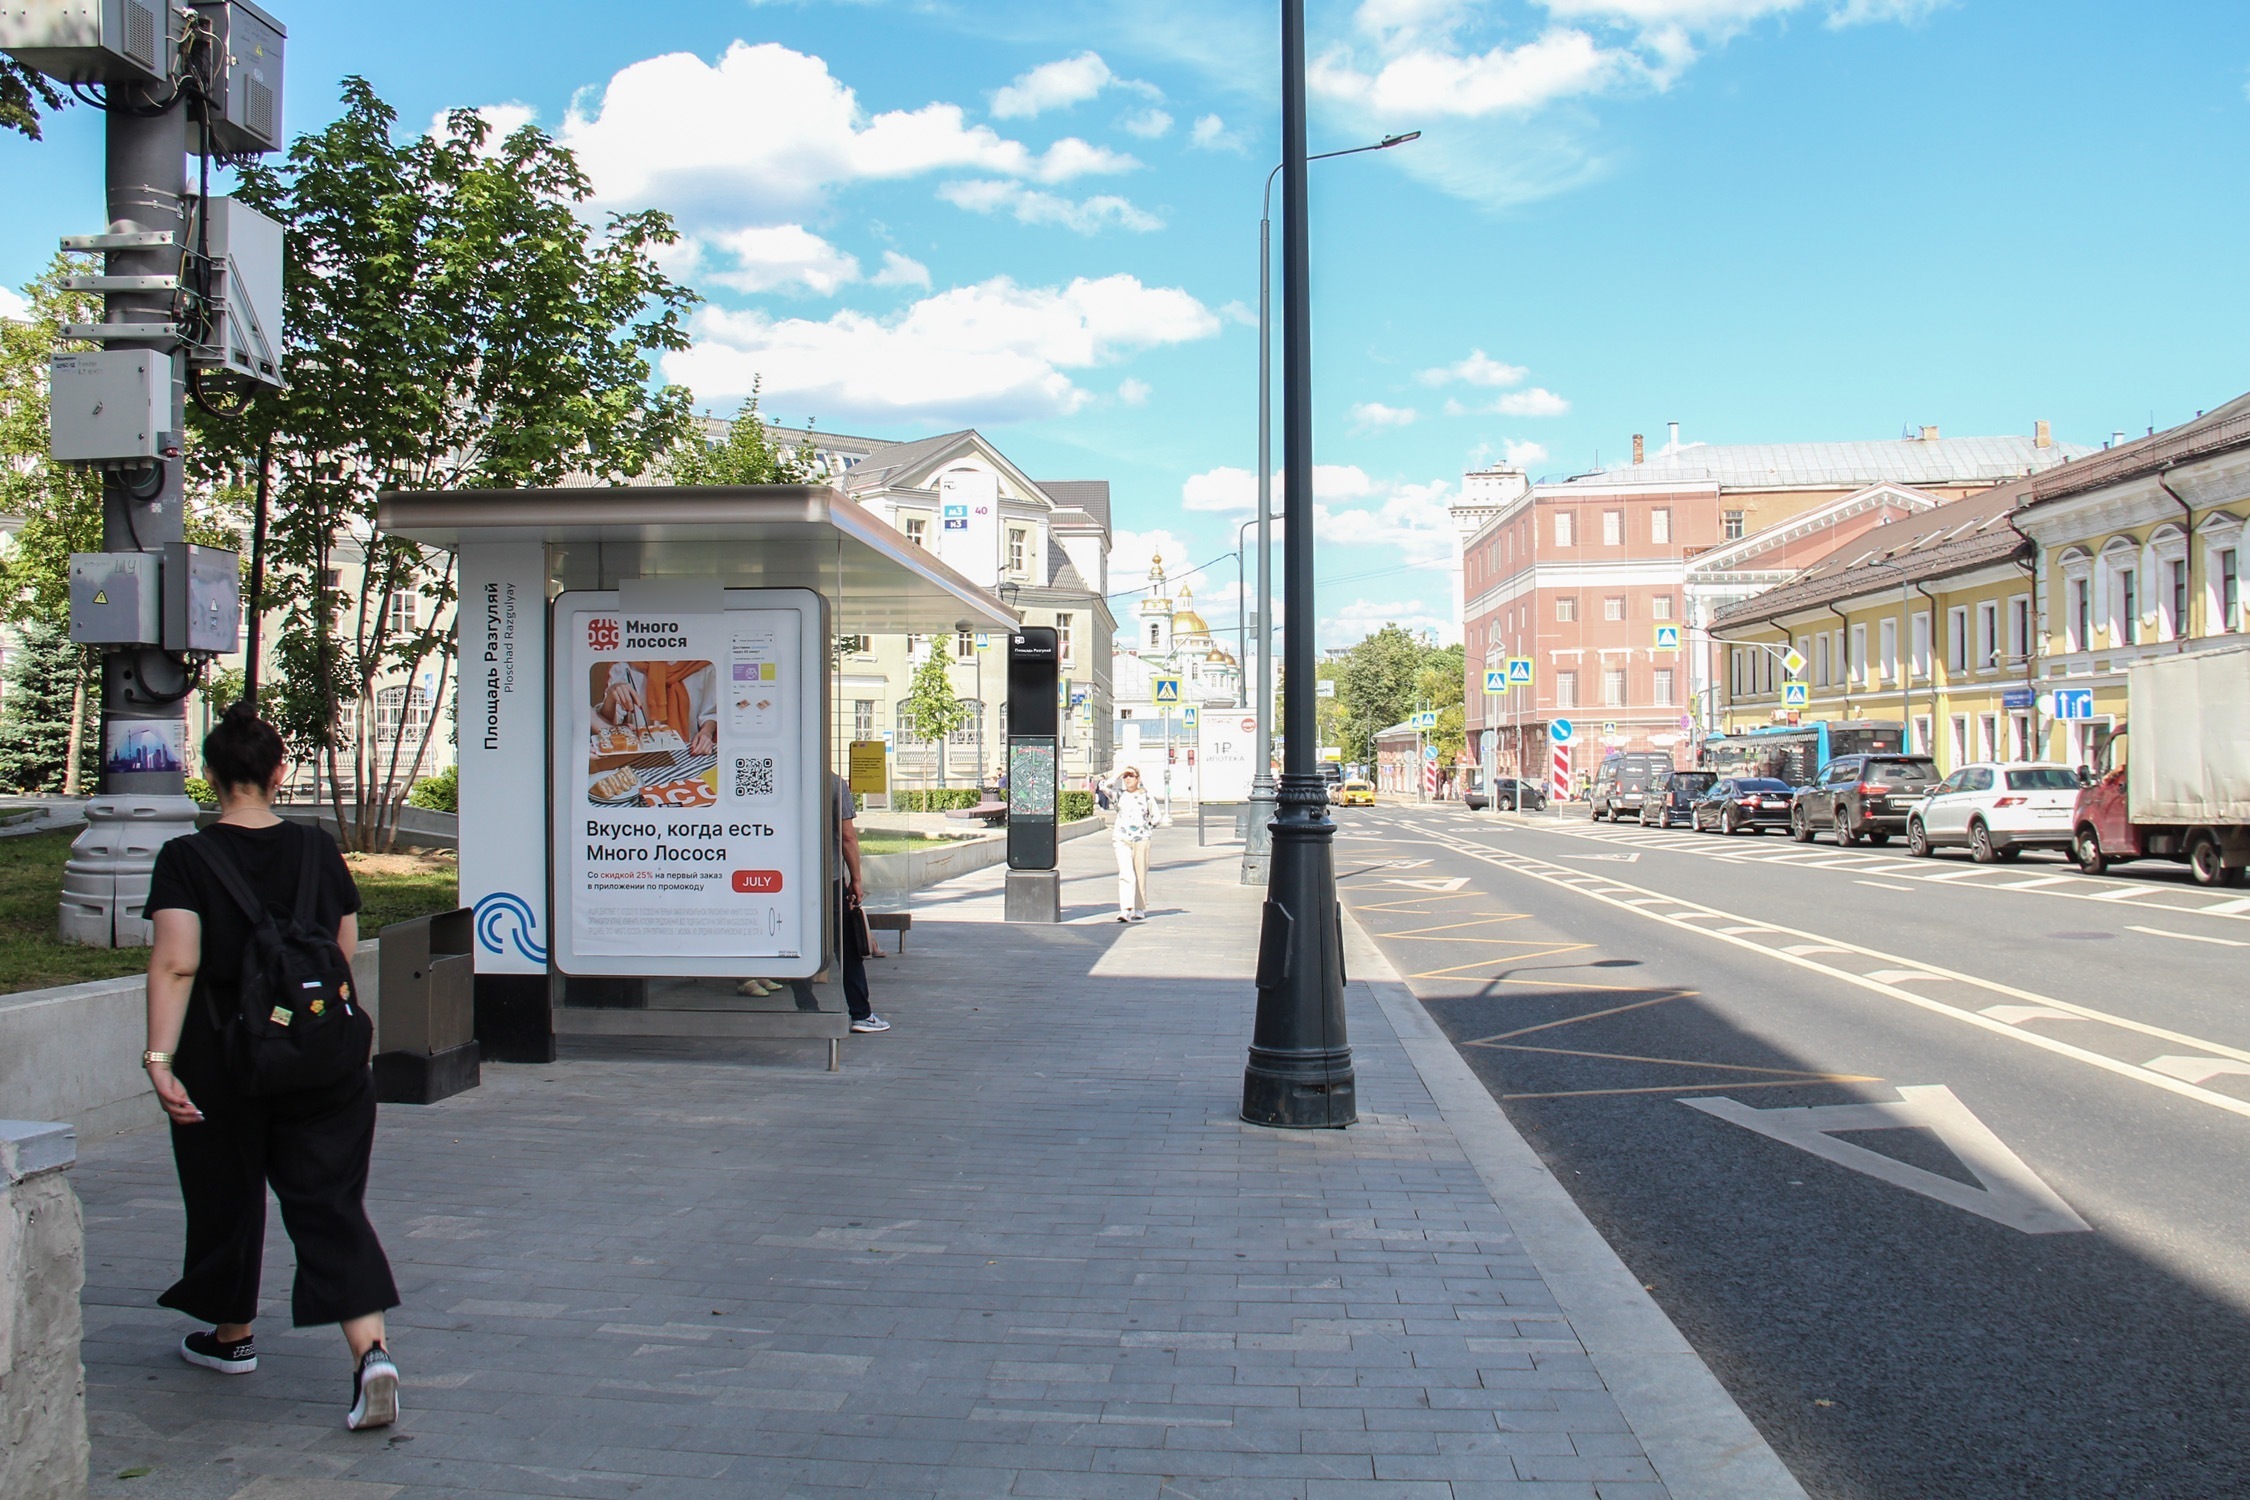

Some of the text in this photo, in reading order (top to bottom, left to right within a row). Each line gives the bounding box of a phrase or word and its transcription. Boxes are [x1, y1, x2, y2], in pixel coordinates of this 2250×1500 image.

[975, 506, 988, 515] 40
[626, 620, 679, 634] Много
[504, 583, 516, 693] Ploschad Razgulyay
[626, 637, 687, 648] лосося
[484, 583, 501, 750] Площадь Разгуляй
[586, 820, 774, 840] Вкусно, когда есть
[586, 844, 727, 861] Много Лосося
[587, 871, 599, 879] Со
[600, 870, 635, 880] скидкой
[636, 871, 653, 879] 25%
[667, 871, 698, 880] первый
[594, 883, 645, 892] приложении
[658, 883, 705, 892] промокоду
[742, 876, 772, 887] JULY
